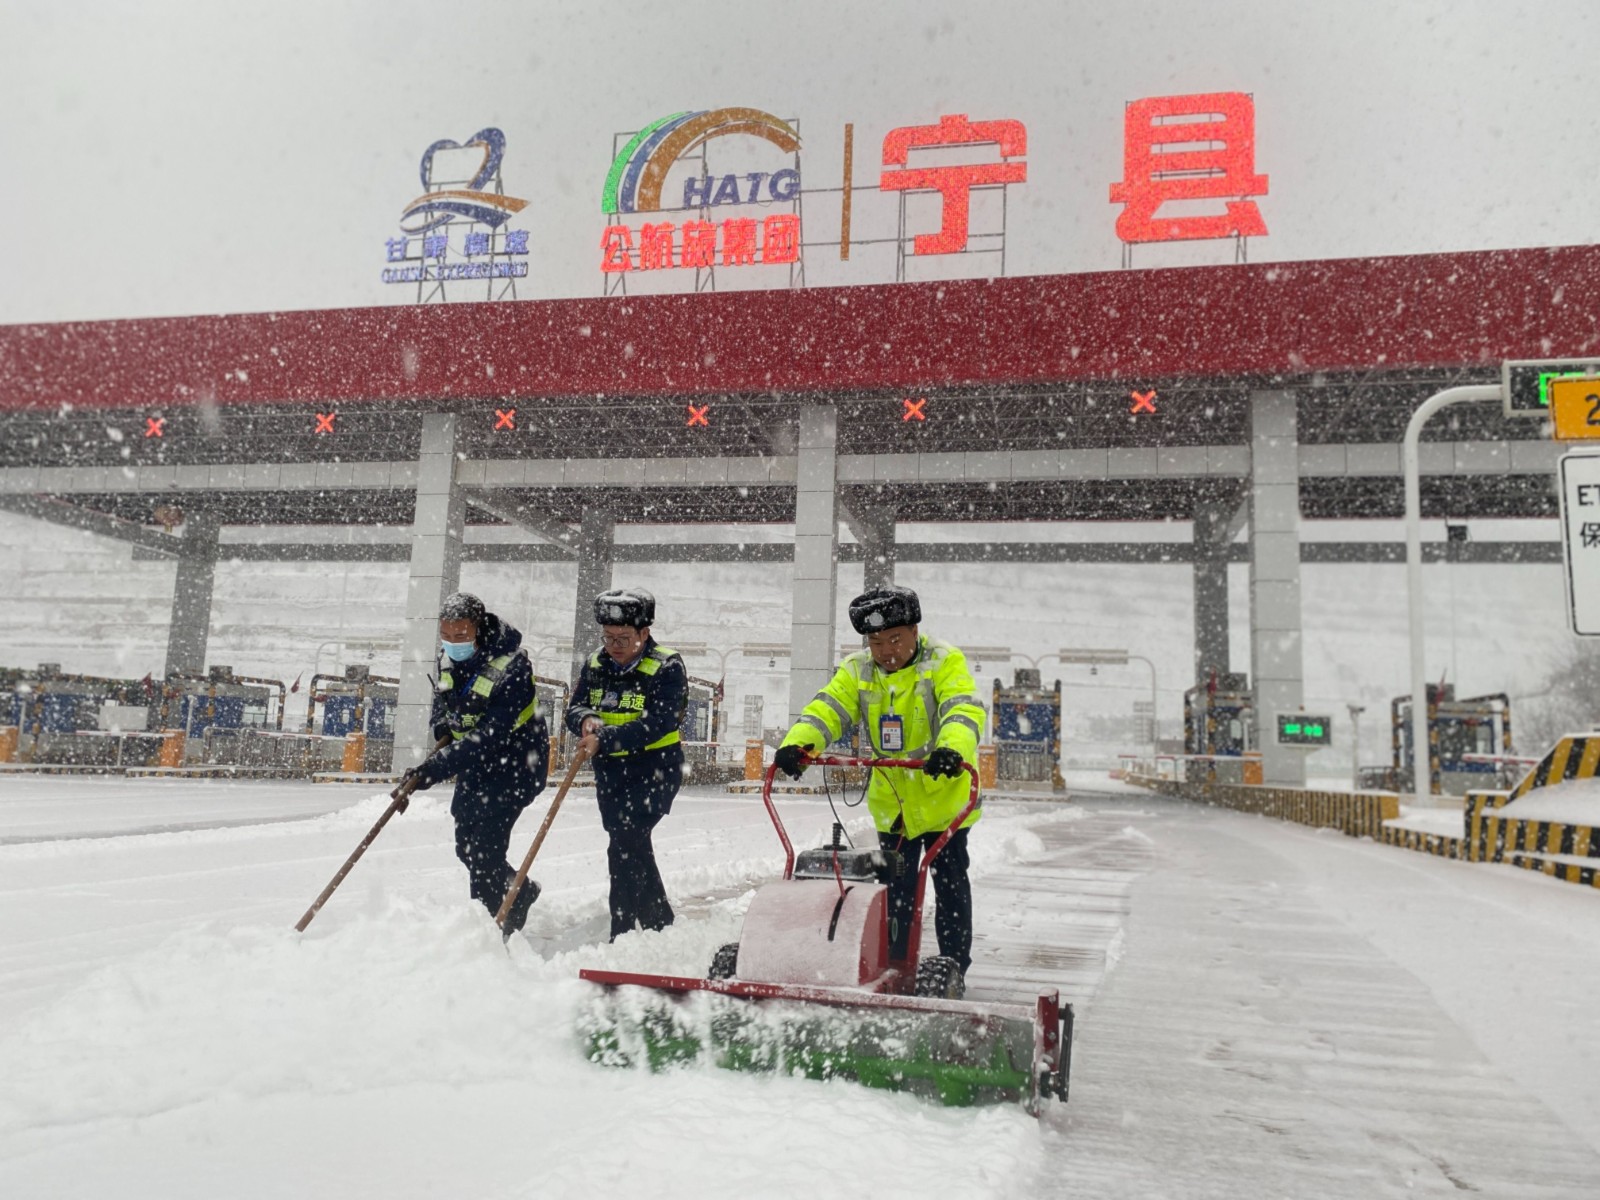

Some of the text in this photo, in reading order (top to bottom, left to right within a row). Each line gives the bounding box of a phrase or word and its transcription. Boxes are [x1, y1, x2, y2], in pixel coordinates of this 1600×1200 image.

[683, 168, 801, 208] HATG
[880, 92, 1269, 256] 宁县
[600, 214, 800, 272] 公航旅集团
[618, 693, 645, 711] 高速
